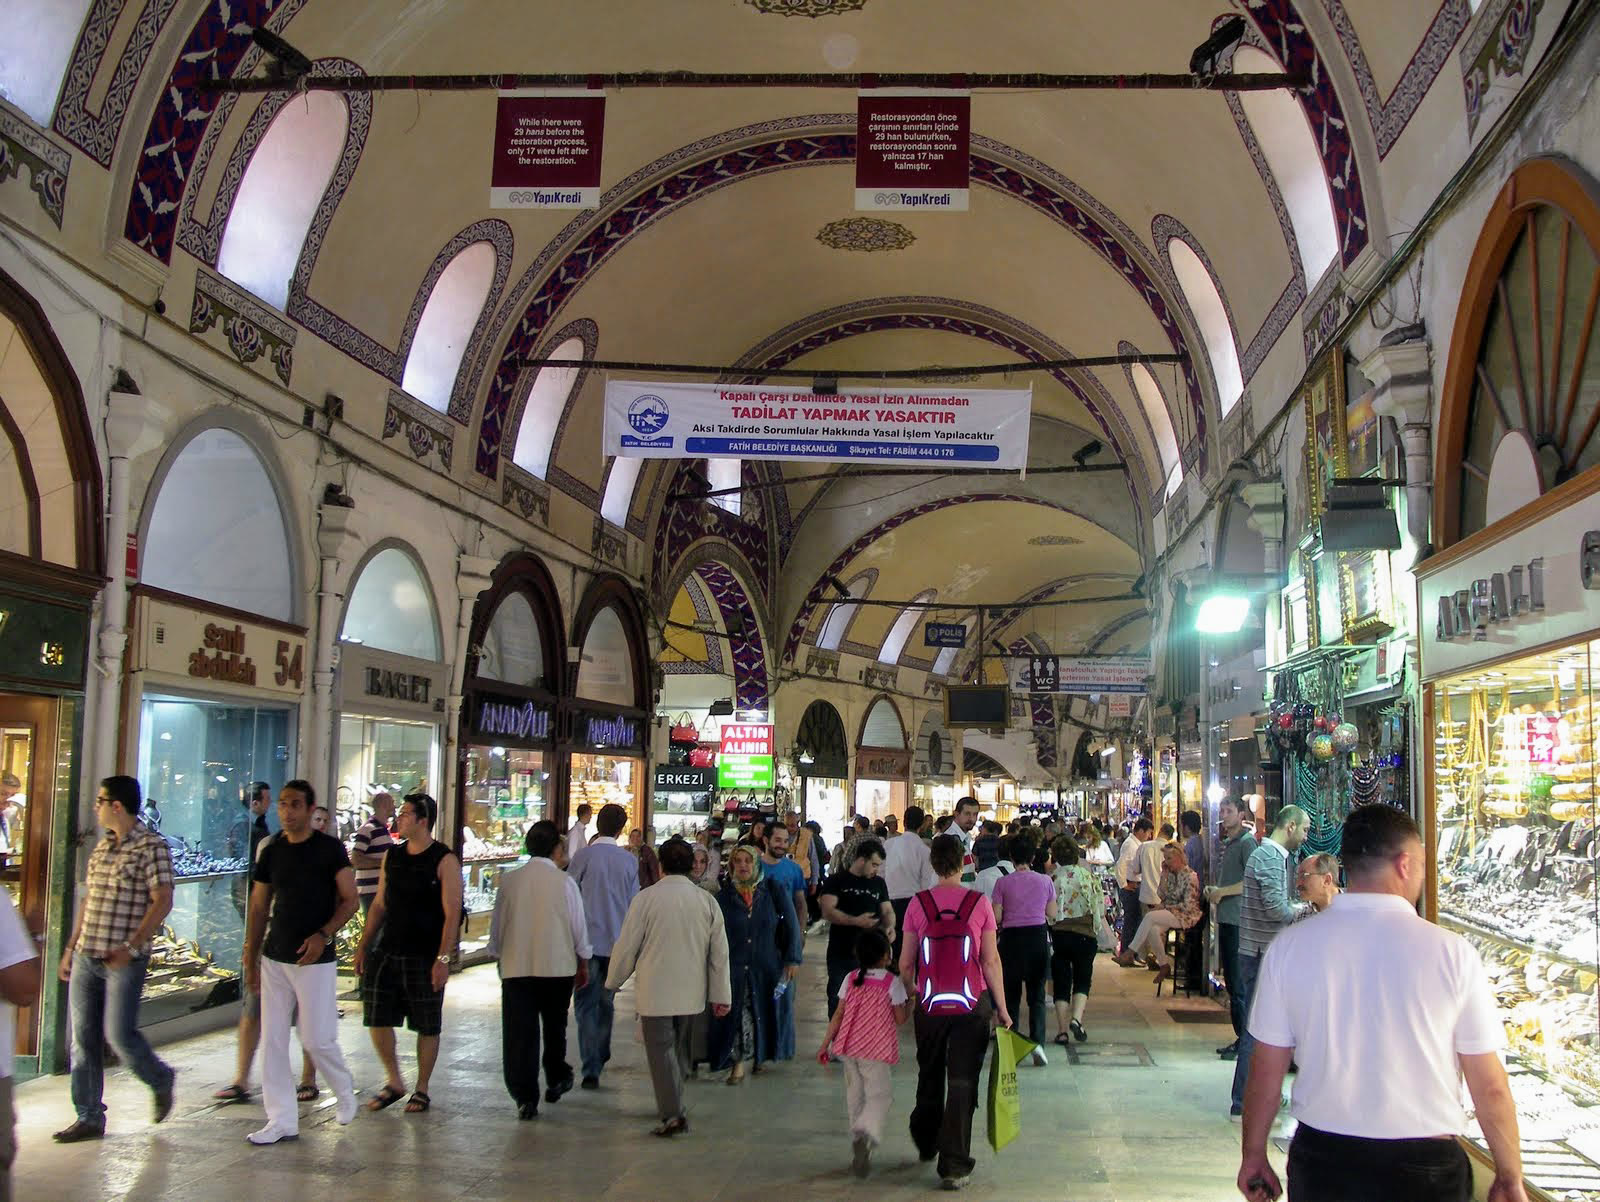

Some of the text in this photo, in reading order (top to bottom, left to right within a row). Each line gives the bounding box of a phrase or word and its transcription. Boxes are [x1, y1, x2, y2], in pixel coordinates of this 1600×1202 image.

[518, 118, 540, 126] While
[541, 118, 562, 126] there
[870, 113, 958, 122] Restorasyondan önce
[514, 128, 585, 136] 29 hans before the
[868, 123, 959, 132] çarşının sınırları içinde
[510, 138, 587, 147] restoration process,
[507, 147, 525, 156] only
[526, 147, 535, 155] 17
[557, 147, 570, 155] left
[570, 147, 589, 155] after
[869, 143, 932, 152] restorasyondan
[518, 157, 577, 165] the restoration.
[882, 152, 916, 162] yalnızca
[894, 162, 932, 171] kalmıştır.
[900, 193, 951, 206] YapıKredi
[720, 391, 756, 403] Kapalı
[760, 392, 789, 404] Çarşı
[850, 394, 880, 404] Yasal
[907, 395, 969, 406] Alınmadan
[732, 405, 956, 424] TADİLAT YAPMAK YASAKTIR
[692, 424, 995, 441] Aksi Takdirde Sorumlular Hakkında Yasal İşlem Yapılacaktır
[729, 440, 750, 451] FATİH
[752, 441, 789, 452] BELEDİYE
[790, 443, 838, 454] BAŞKANLIĞI
[849, 445, 877, 455] Şikayet
[879, 446, 891, 454] Tel:
[893, 446, 917, 456] FABİM
[919, 448, 933, 456] 444
[941, 448, 955, 457] 176
[274, 639, 303, 689] 54
[1035, 677, 1055, 685] WC
[724, 726, 769, 739] ALTIN
[723, 741, 768, 754] ALINIR
[654, 773, 704, 785] ERKEZİ
